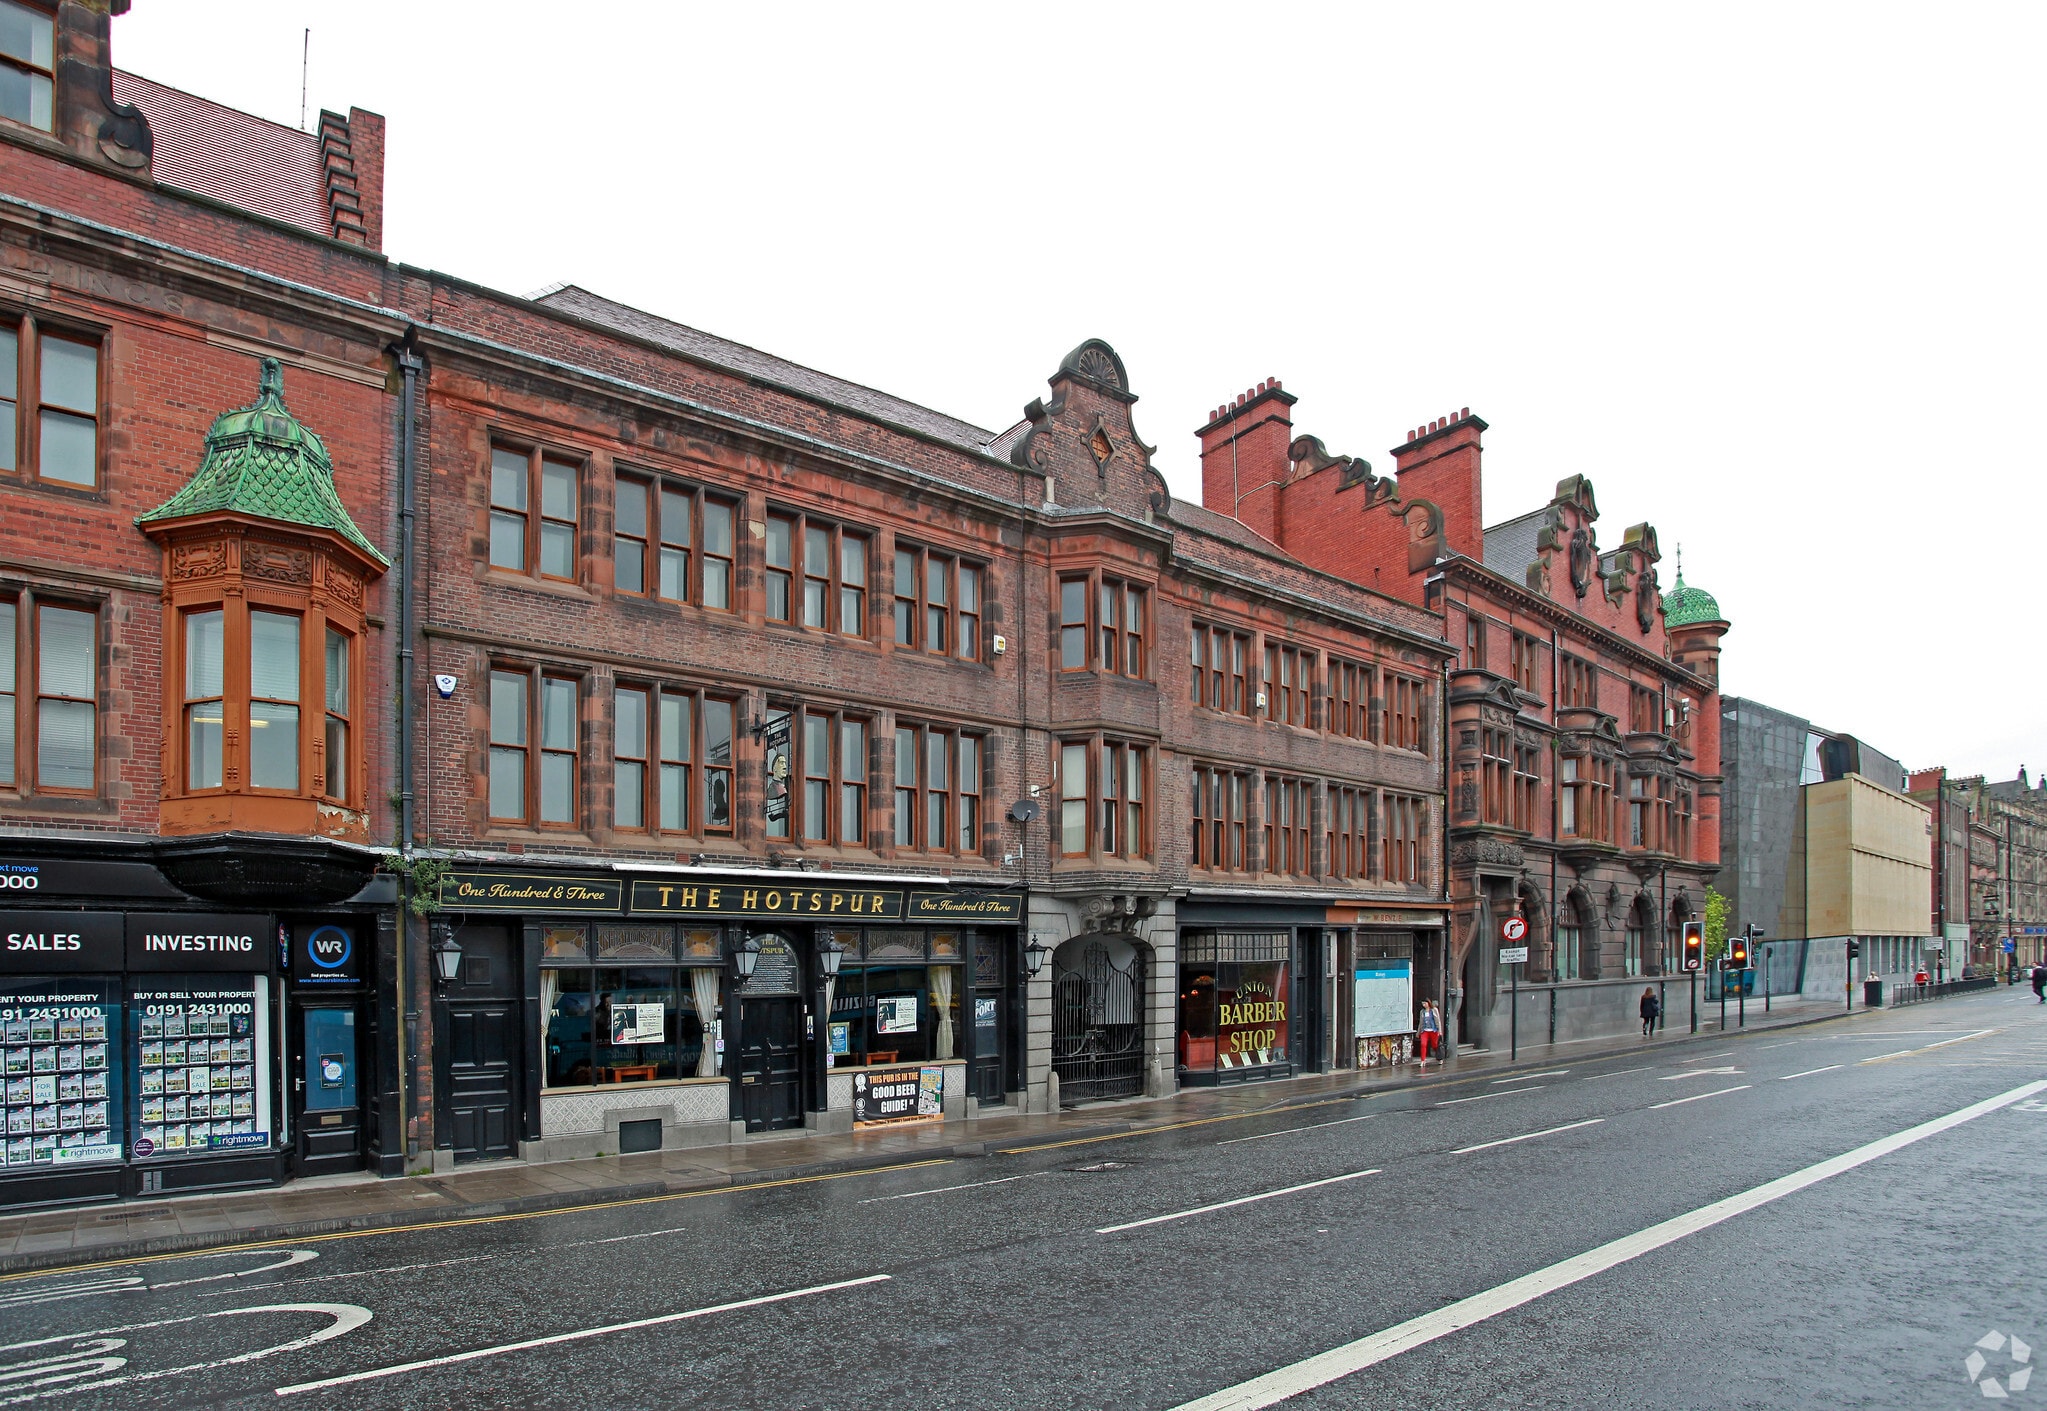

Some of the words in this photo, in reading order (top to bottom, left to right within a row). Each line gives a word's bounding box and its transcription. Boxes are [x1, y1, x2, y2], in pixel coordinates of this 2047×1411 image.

[11, 865, 39, 873] move
[458, 882, 485, 897] One
[488, 883, 553, 899] Hundred
[553, 886, 564, 899] &
[566, 886, 605, 900] Three
[658, 886, 721, 908] THE
[742, 889, 884, 913] HOTSPUR
[920, 899, 937, 910] One
[938, 899, 979, 911] Hundred
[978, 901, 986, 912] &
[986, 902, 1011, 912] Three
[7, 934, 81, 951] SALES
[145, 934, 253, 952] INVESTING
[315, 940, 343, 954] WR
[134, 992, 153, 1000] BUY
[170, 991, 191, 999] SELL
[193, 991, 217, 999] YOUR
[1236, 981, 1274, 999] UNION
[17, 995, 46, 1003] YOUR
[48, 994, 99, 1002] PROPERTY
[29, 1007, 101, 1020] 2431000
[146, 1004, 183, 1016] 0191
[188, 1003, 251, 1015] 2431000
[1219, 1001, 1287, 1026] BARBER
[1230, 1029, 1277, 1054] SHOP
[869, 1074, 882, 1084] THIS
[883, 1073, 895, 1083] PUB
[895, 1073, 900, 1082] IS
[902, 1072, 908, 1081] IN
[908, 1072, 919, 1080] THE
[872, 1085, 895, 1099] GOOD
[896, 1084, 916, 1097] BEER
[881, 1099, 908, 1113] GUIDE!
[222, 1135, 264, 1147] rightmove
[70, 1146, 115, 1159] rightmove
